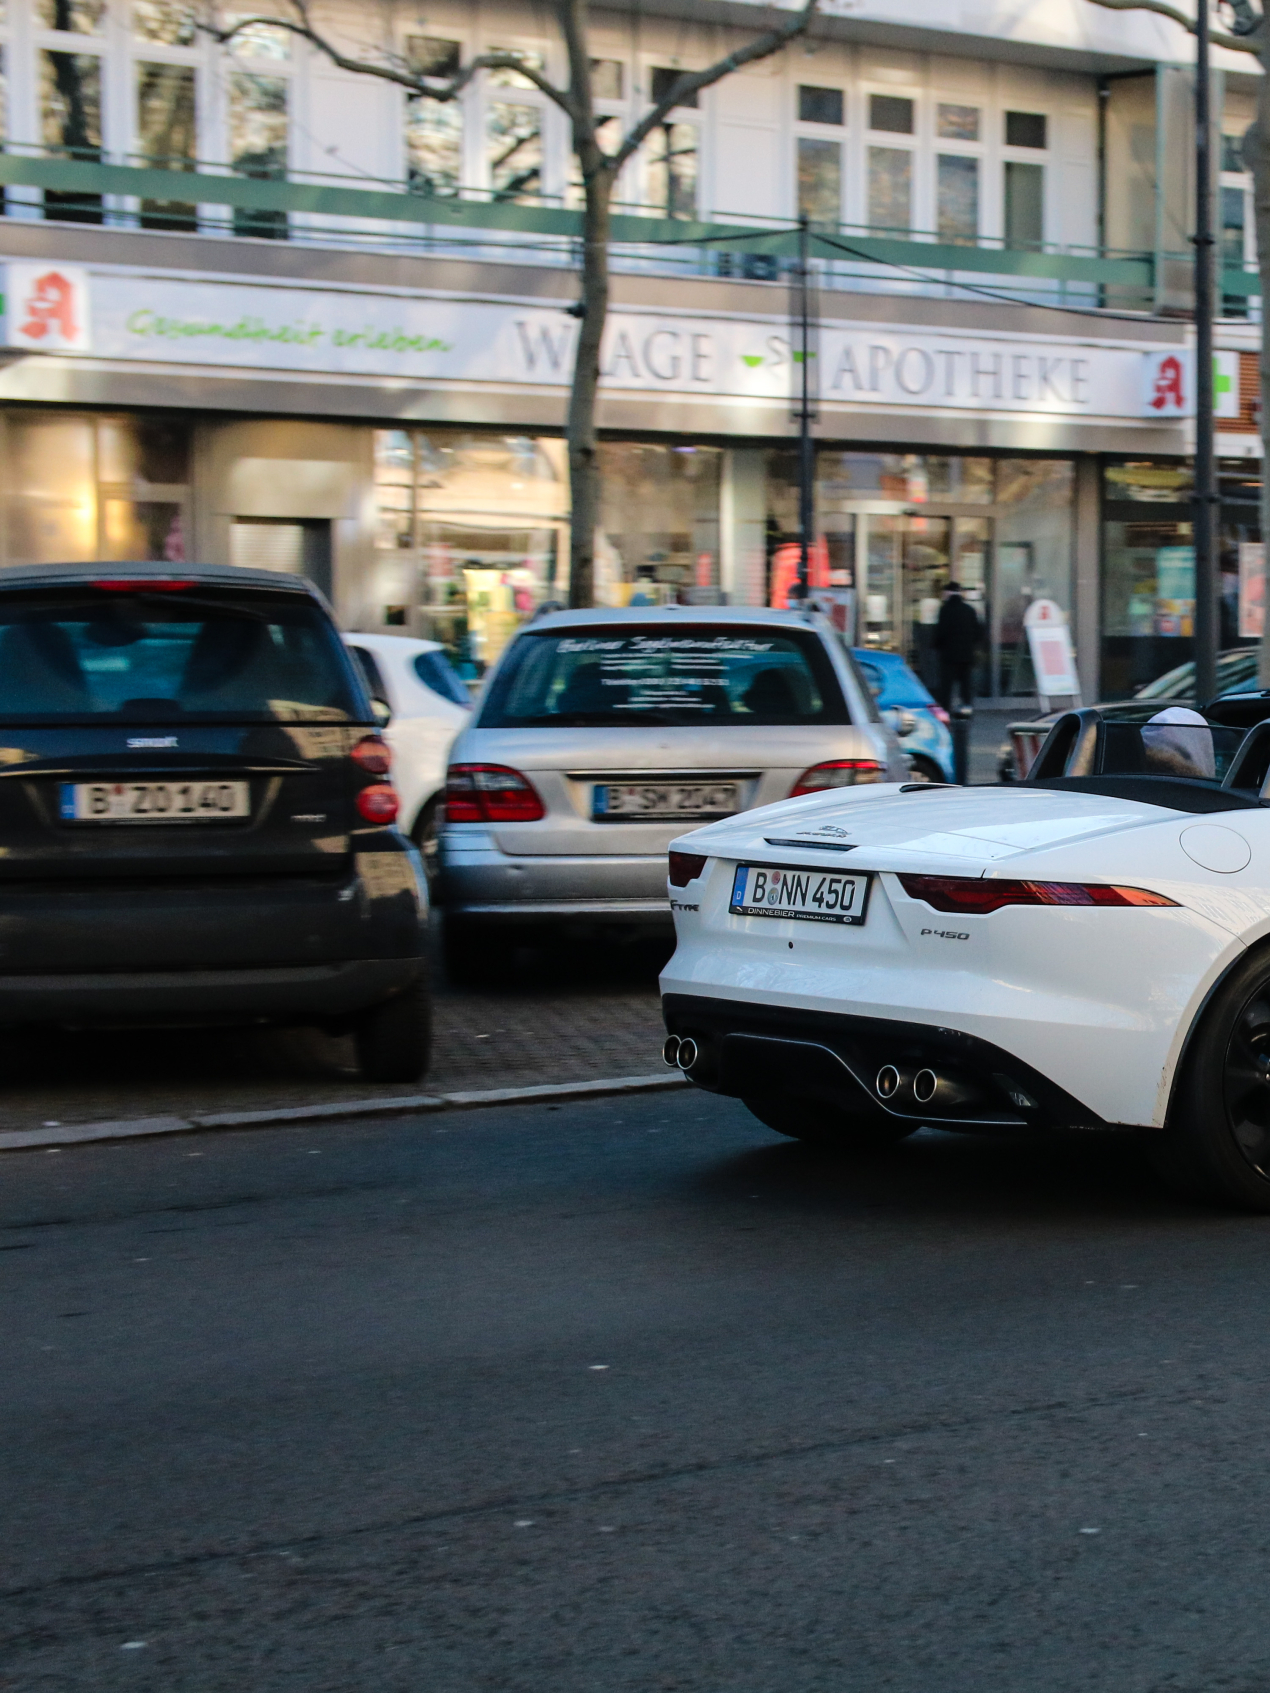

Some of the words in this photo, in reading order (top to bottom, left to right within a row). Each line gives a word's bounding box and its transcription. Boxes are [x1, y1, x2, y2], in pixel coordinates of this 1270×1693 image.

[125, 309, 327, 346] Gesundheit
[514, 320, 712, 382] WAGE
[831, 343, 1090, 404] APOTHEKE
[89, 786, 110, 814] B
[608, 788, 622, 810] B
[752, 872, 768, 903] B
[779, 873, 810, 907] NN
[811, 877, 856, 911] 450
[747, 907, 795, 918] DINNEBIER
[920, 928, 970, 940] P450
